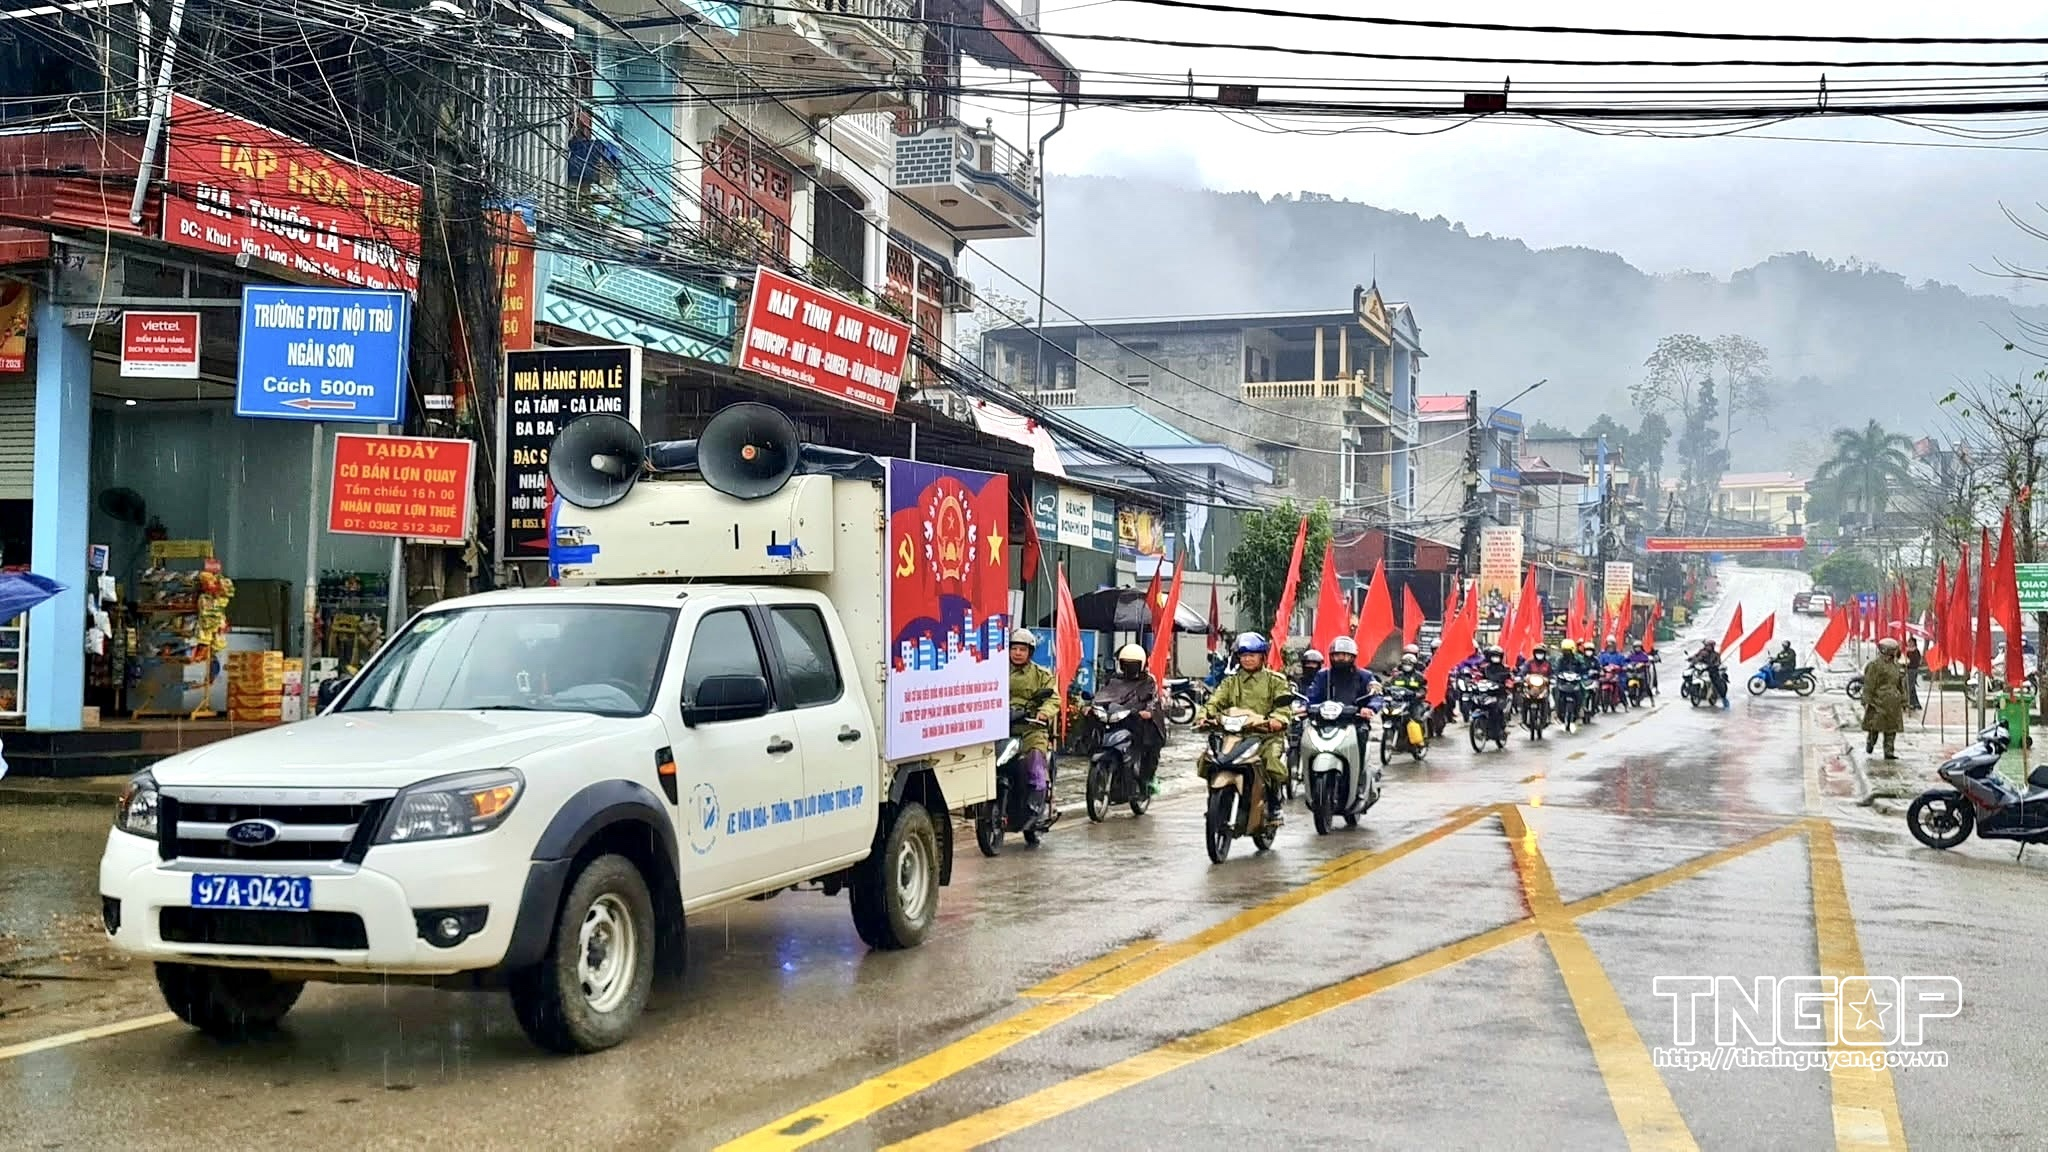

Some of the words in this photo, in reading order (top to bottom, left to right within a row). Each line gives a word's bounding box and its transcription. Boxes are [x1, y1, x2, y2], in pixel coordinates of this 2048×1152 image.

[141, 320, 181, 331] viettel
[254, 299, 304, 328] TRƯỜNG
[308, 306, 340, 330] PTDT
[342, 303, 365, 336] NỘI
[369, 304, 393, 332] TRÚ
[767, 288, 799, 320] MÁY
[802, 299, 832, 332] TÍNH
[835, 315, 863, 343] ANH
[288, 338, 324, 367] NGÂN
[327, 342, 354, 368] SƠN
[263, 376, 311, 394] Cách
[321, 379, 374, 397] 500m
[514, 367, 540, 391] NHÀ
[543, 366, 577, 390] HÀNG
[580, 369, 605, 389] HOA
[608, 364, 623, 389] LÊ
[514, 396, 531, 414] CÁ
[570, 395, 587, 413] CÁ
[590, 394, 622, 412] LĂNG
[515, 421, 534, 436] BA
[536, 421, 554, 436] BA
[513, 445, 538, 468] ĐẶC
[340, 462, 358, 478] CÓ
[362, 463, 390, 479] BÁN
[393, 466, 420, 483] LỢN
[424, 468, 457, 483] QUAY
[412, 489, 425, 499] 16
[428, 489, 436, 499] h
[441, 489, 455, 500] 00
[512, 494, 530, 512] HỘI
[340, 499, 372, 515] NHẬN
[374, 502, 401, 515] QUAY
[405, 504, 426, 518] LỢN
[430, 504, 457, 519] THUÊ
[343, 519, 364, 529] ĐT:
[369, 520, 398, 531] 0382
[402, 522, 424, 532] 512
[429, 524, 451, 533] 387
[2021, 580, 2048, 589] GIAO
[793, 798, 804, 820] TIN
